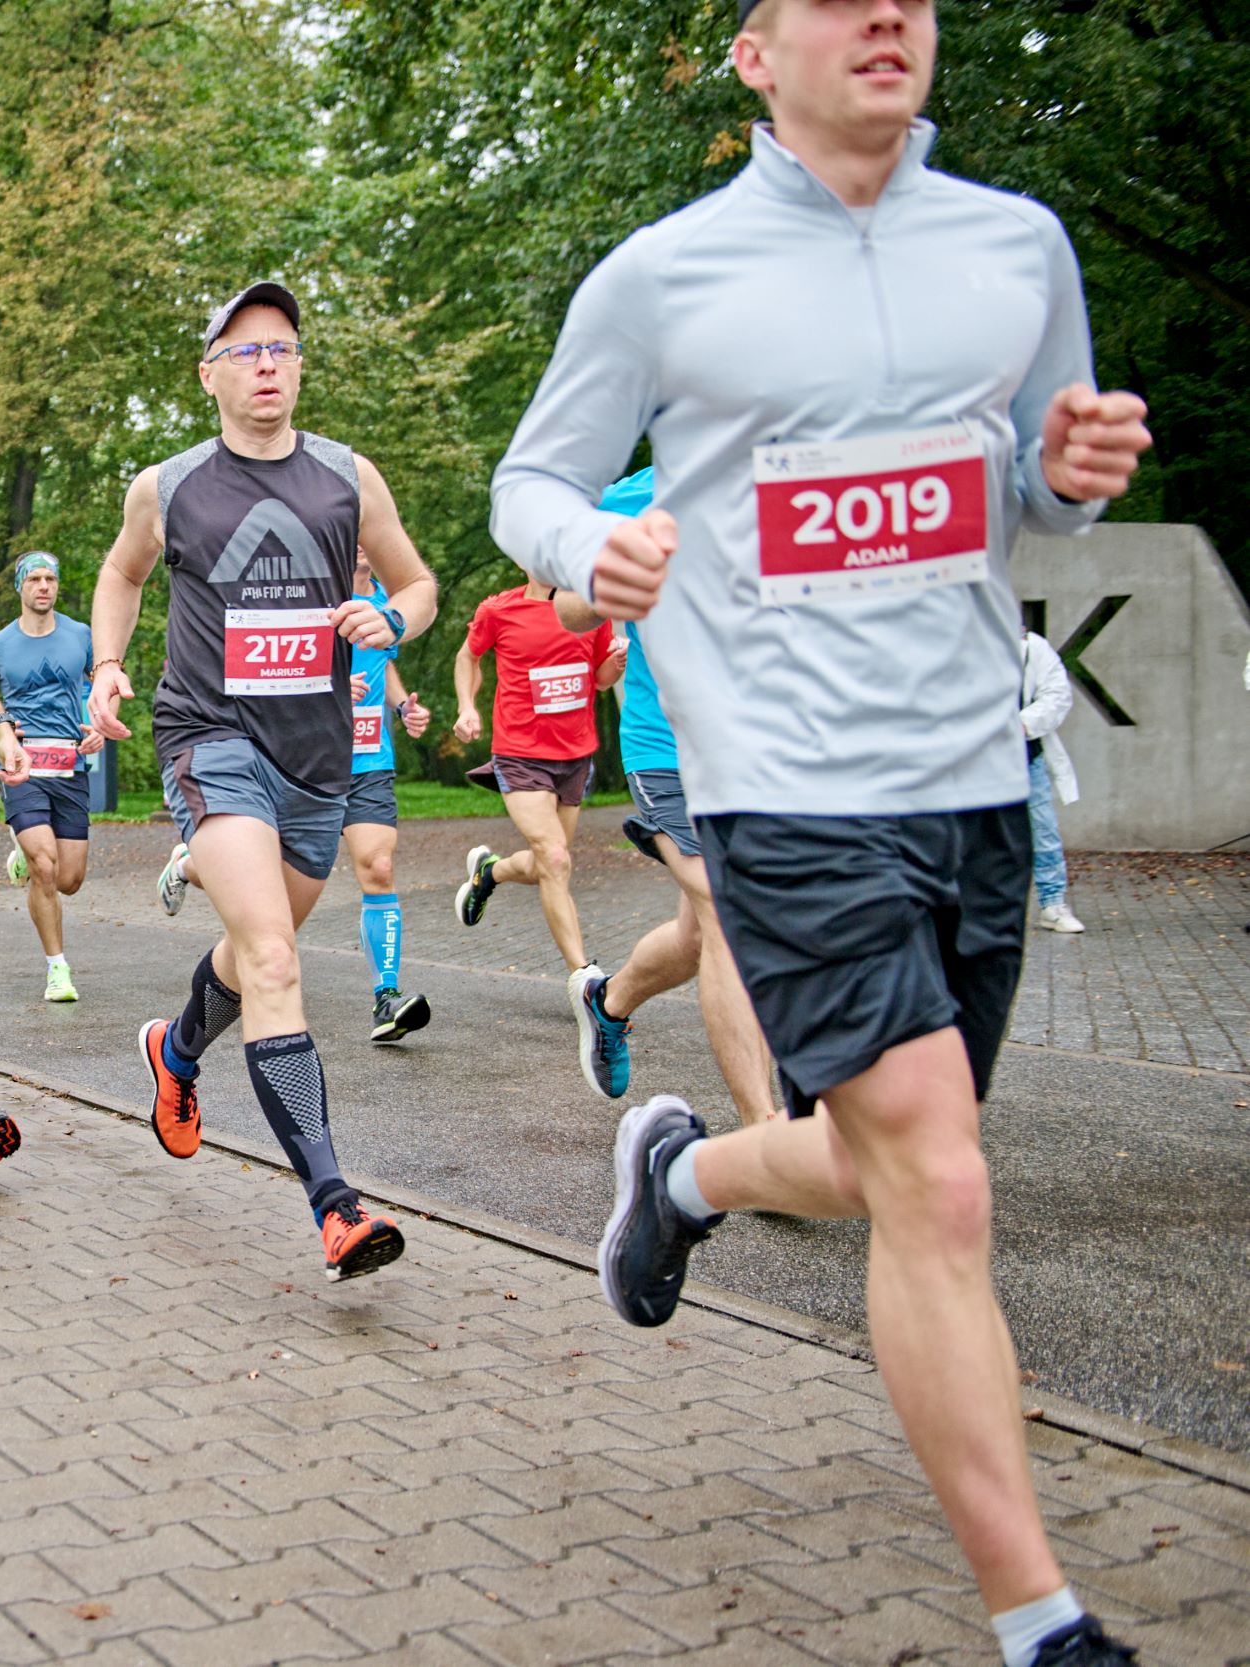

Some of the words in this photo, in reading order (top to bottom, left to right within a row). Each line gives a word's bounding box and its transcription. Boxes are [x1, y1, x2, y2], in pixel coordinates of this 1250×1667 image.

[790, 475, 951, 545] 2019
[844, 544, 909, 567] ADAM
[285, 585, 306, 598] RUN
[244, 633, 317, 663] 2173
[260, 667, 305, 677] MARIUSZ
[539, 677, 582, 697] 2538
[354, 720, 376, 737] 95
[31, 752, 69, 766] 2792
